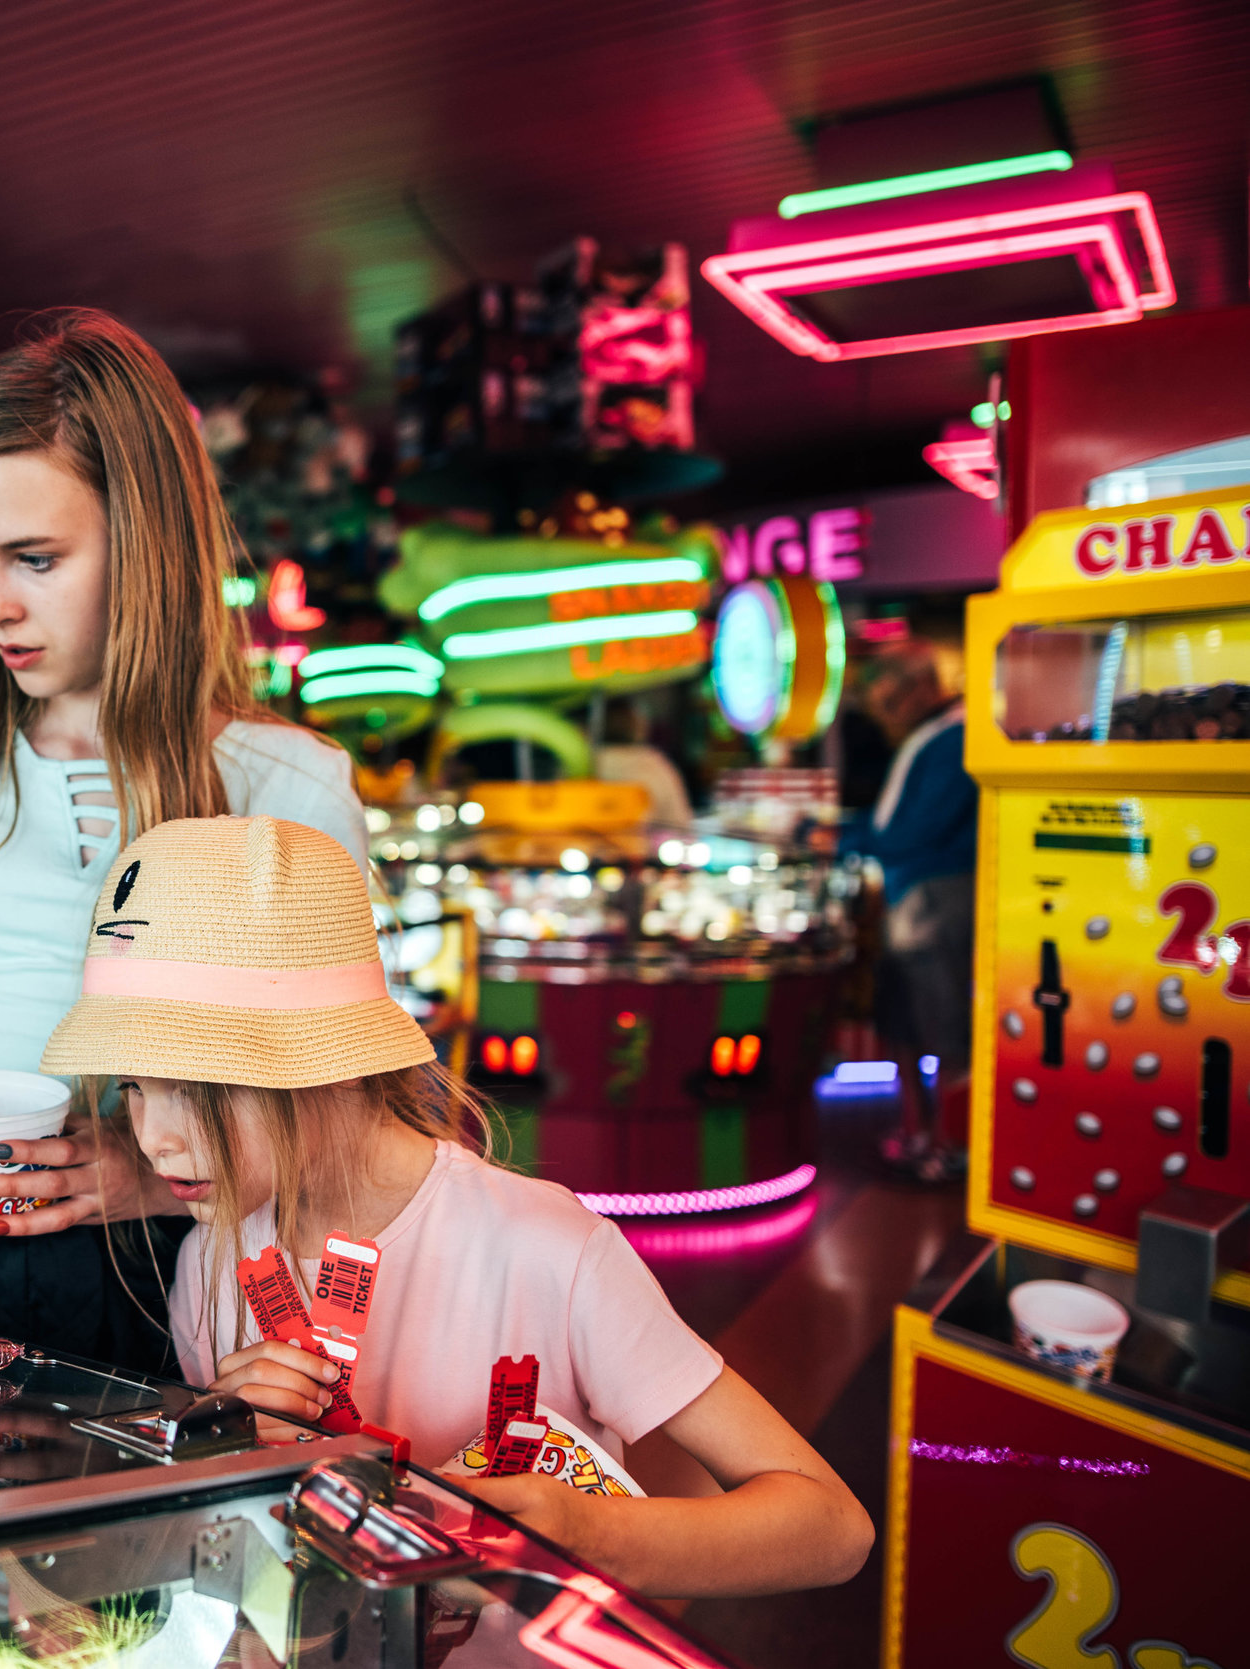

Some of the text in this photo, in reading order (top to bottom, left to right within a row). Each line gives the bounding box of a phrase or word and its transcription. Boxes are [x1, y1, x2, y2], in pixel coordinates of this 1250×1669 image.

[273, 1252, 312, 1328] AND BETTER PRIZES
[274, 1269, 300, 1317] FOR BIGGER
[316, 1261, 335, 1299] ONE
[353, 1265, 373, 1315] TICKET
[243, 1283, 270, 1334] COLLECT
[333, 1393, 346, 1410] FOR
[337, 1383, 351, 1404] BETT
[347, 1404, 361, 1421] AND
[488, 1381, 501, 1441] COLLECT
